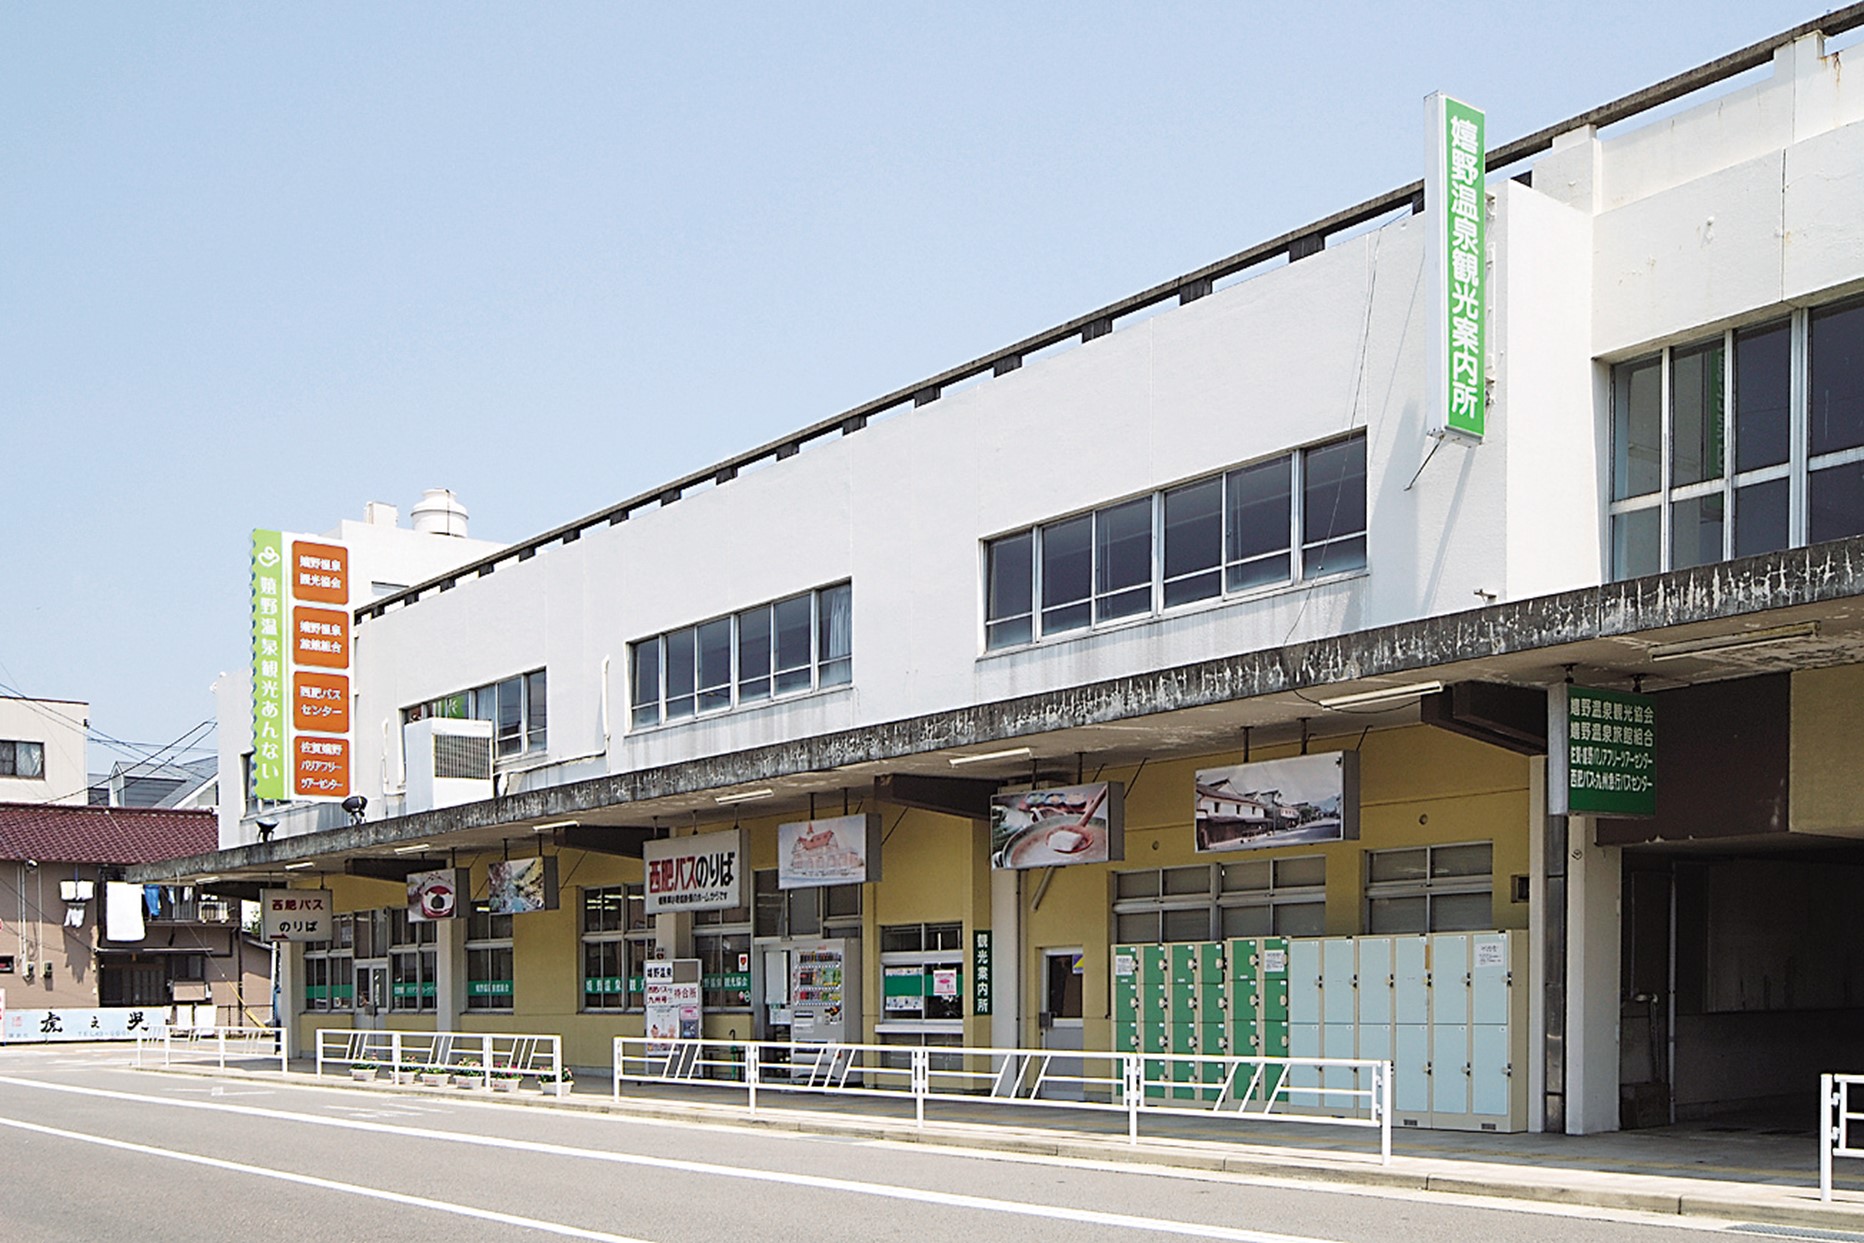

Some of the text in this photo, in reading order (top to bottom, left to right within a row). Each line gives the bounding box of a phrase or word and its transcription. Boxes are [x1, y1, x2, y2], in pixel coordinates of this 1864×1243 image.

[1449, 116, 1479, 420] 嬉野温泉観光案内所
[300, 555, 341, 572] 嬉野温泉
[300, 573, 341, 589] 観光協会
[300, 620, 342, 636] 嬉野温泉
[260, 576, 280, 779] 嬉野温泉観光あんない
[300, 685, 341, 701] 西肥バス
[301, 704, 342, 717] センター
[1570, 697, 1654, 725] 嬉野温泉観光協会
[1570, 721, 1654, 747] 嬉野温泉旅館組合
[300, 760, 342, 773] バリアフリー
[301, 777, 343, 790] ツアーセンター
[648, 851, 735, 894] 西肥バスのりば
[272, 899, 323, 911] 西肥バス
[279, 921, 318, 932] のりば
[977, 933, 988, 1013] 観光案内所
